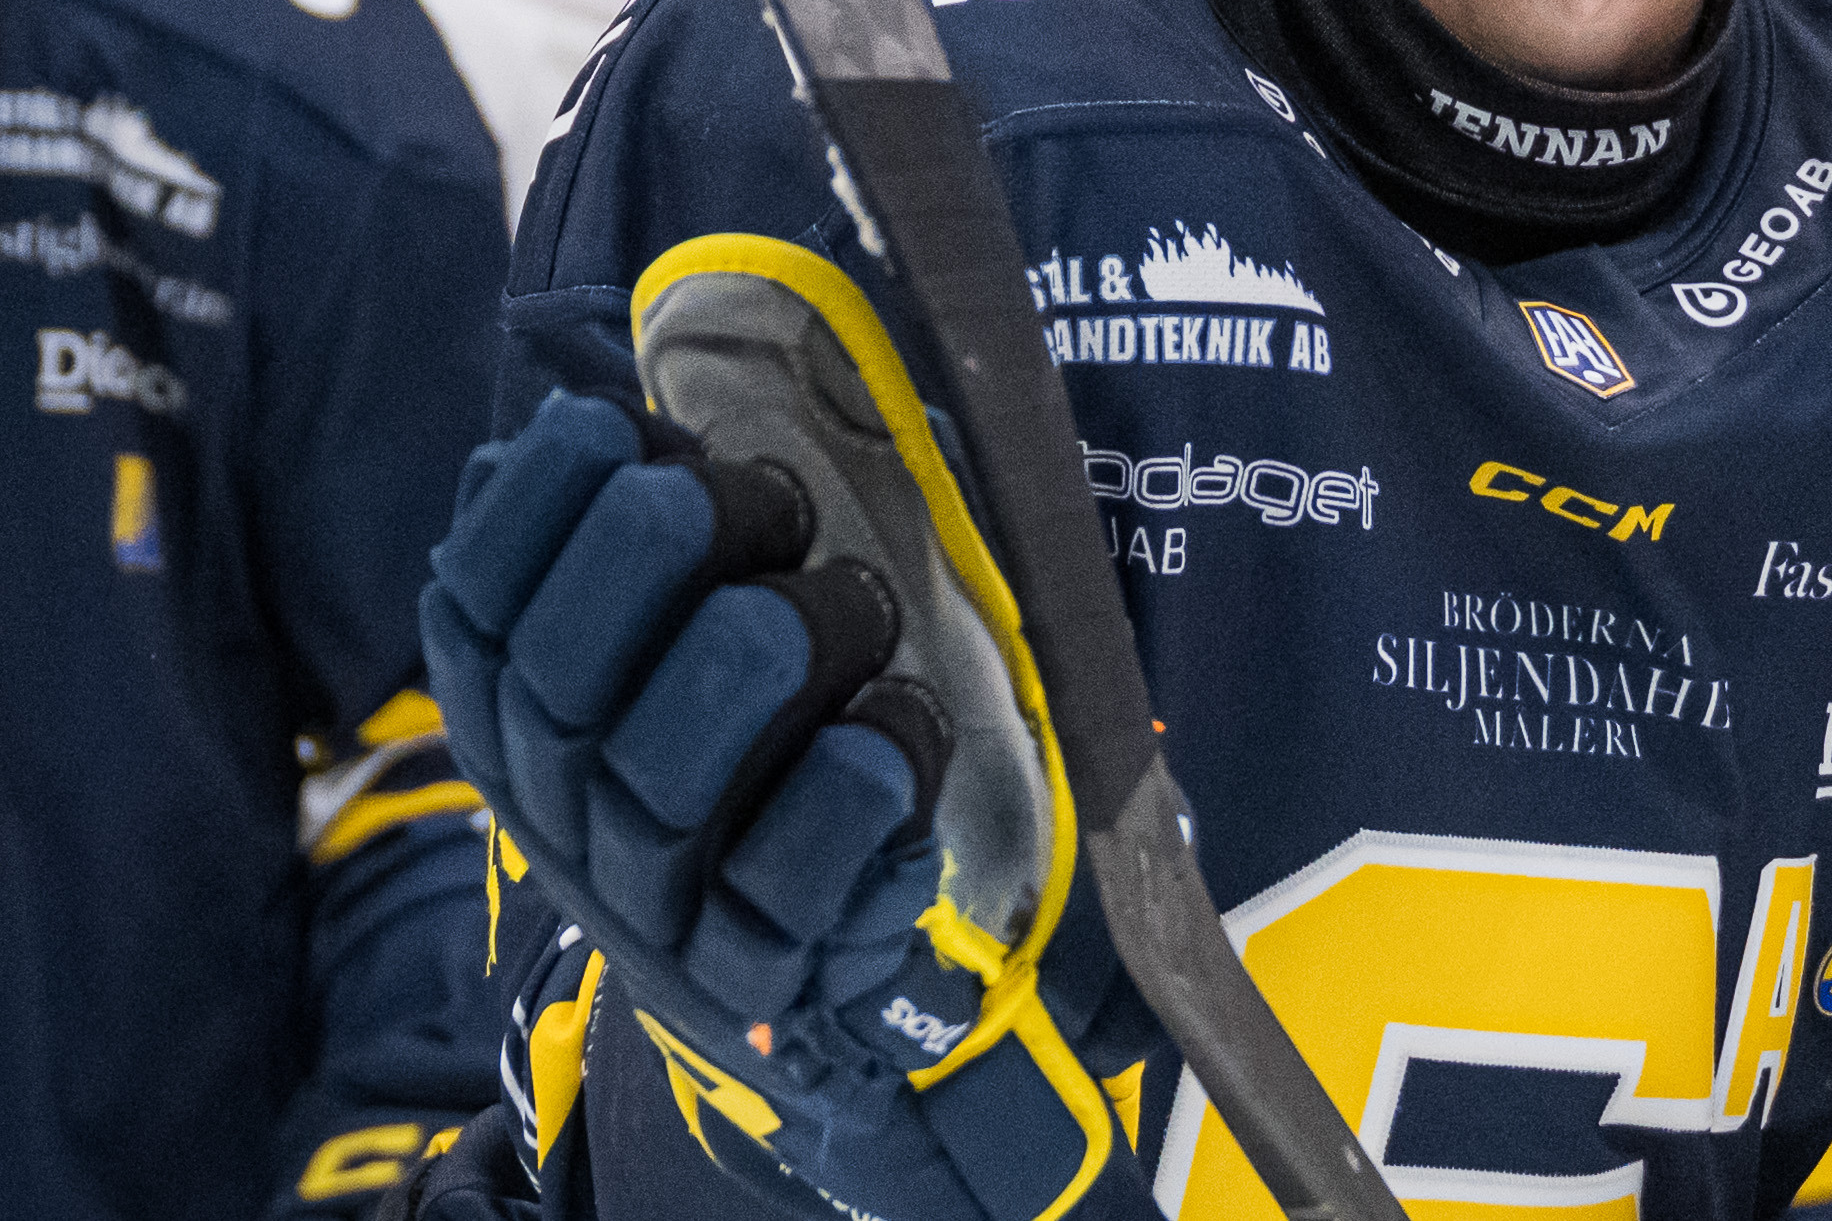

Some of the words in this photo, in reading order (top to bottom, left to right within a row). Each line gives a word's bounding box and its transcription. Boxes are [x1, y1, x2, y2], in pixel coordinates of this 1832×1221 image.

[1100, 252, 1137, 304] &
[1043, 314, 1279, 368] ANDTEKNIK
[1287, 318, 1332, 376] AB
[1468, 460, 1676, 542] CCM
[1127, 525, 1187, 575] AB
[1443, 590, 1693, 668] BRÖDERNA
